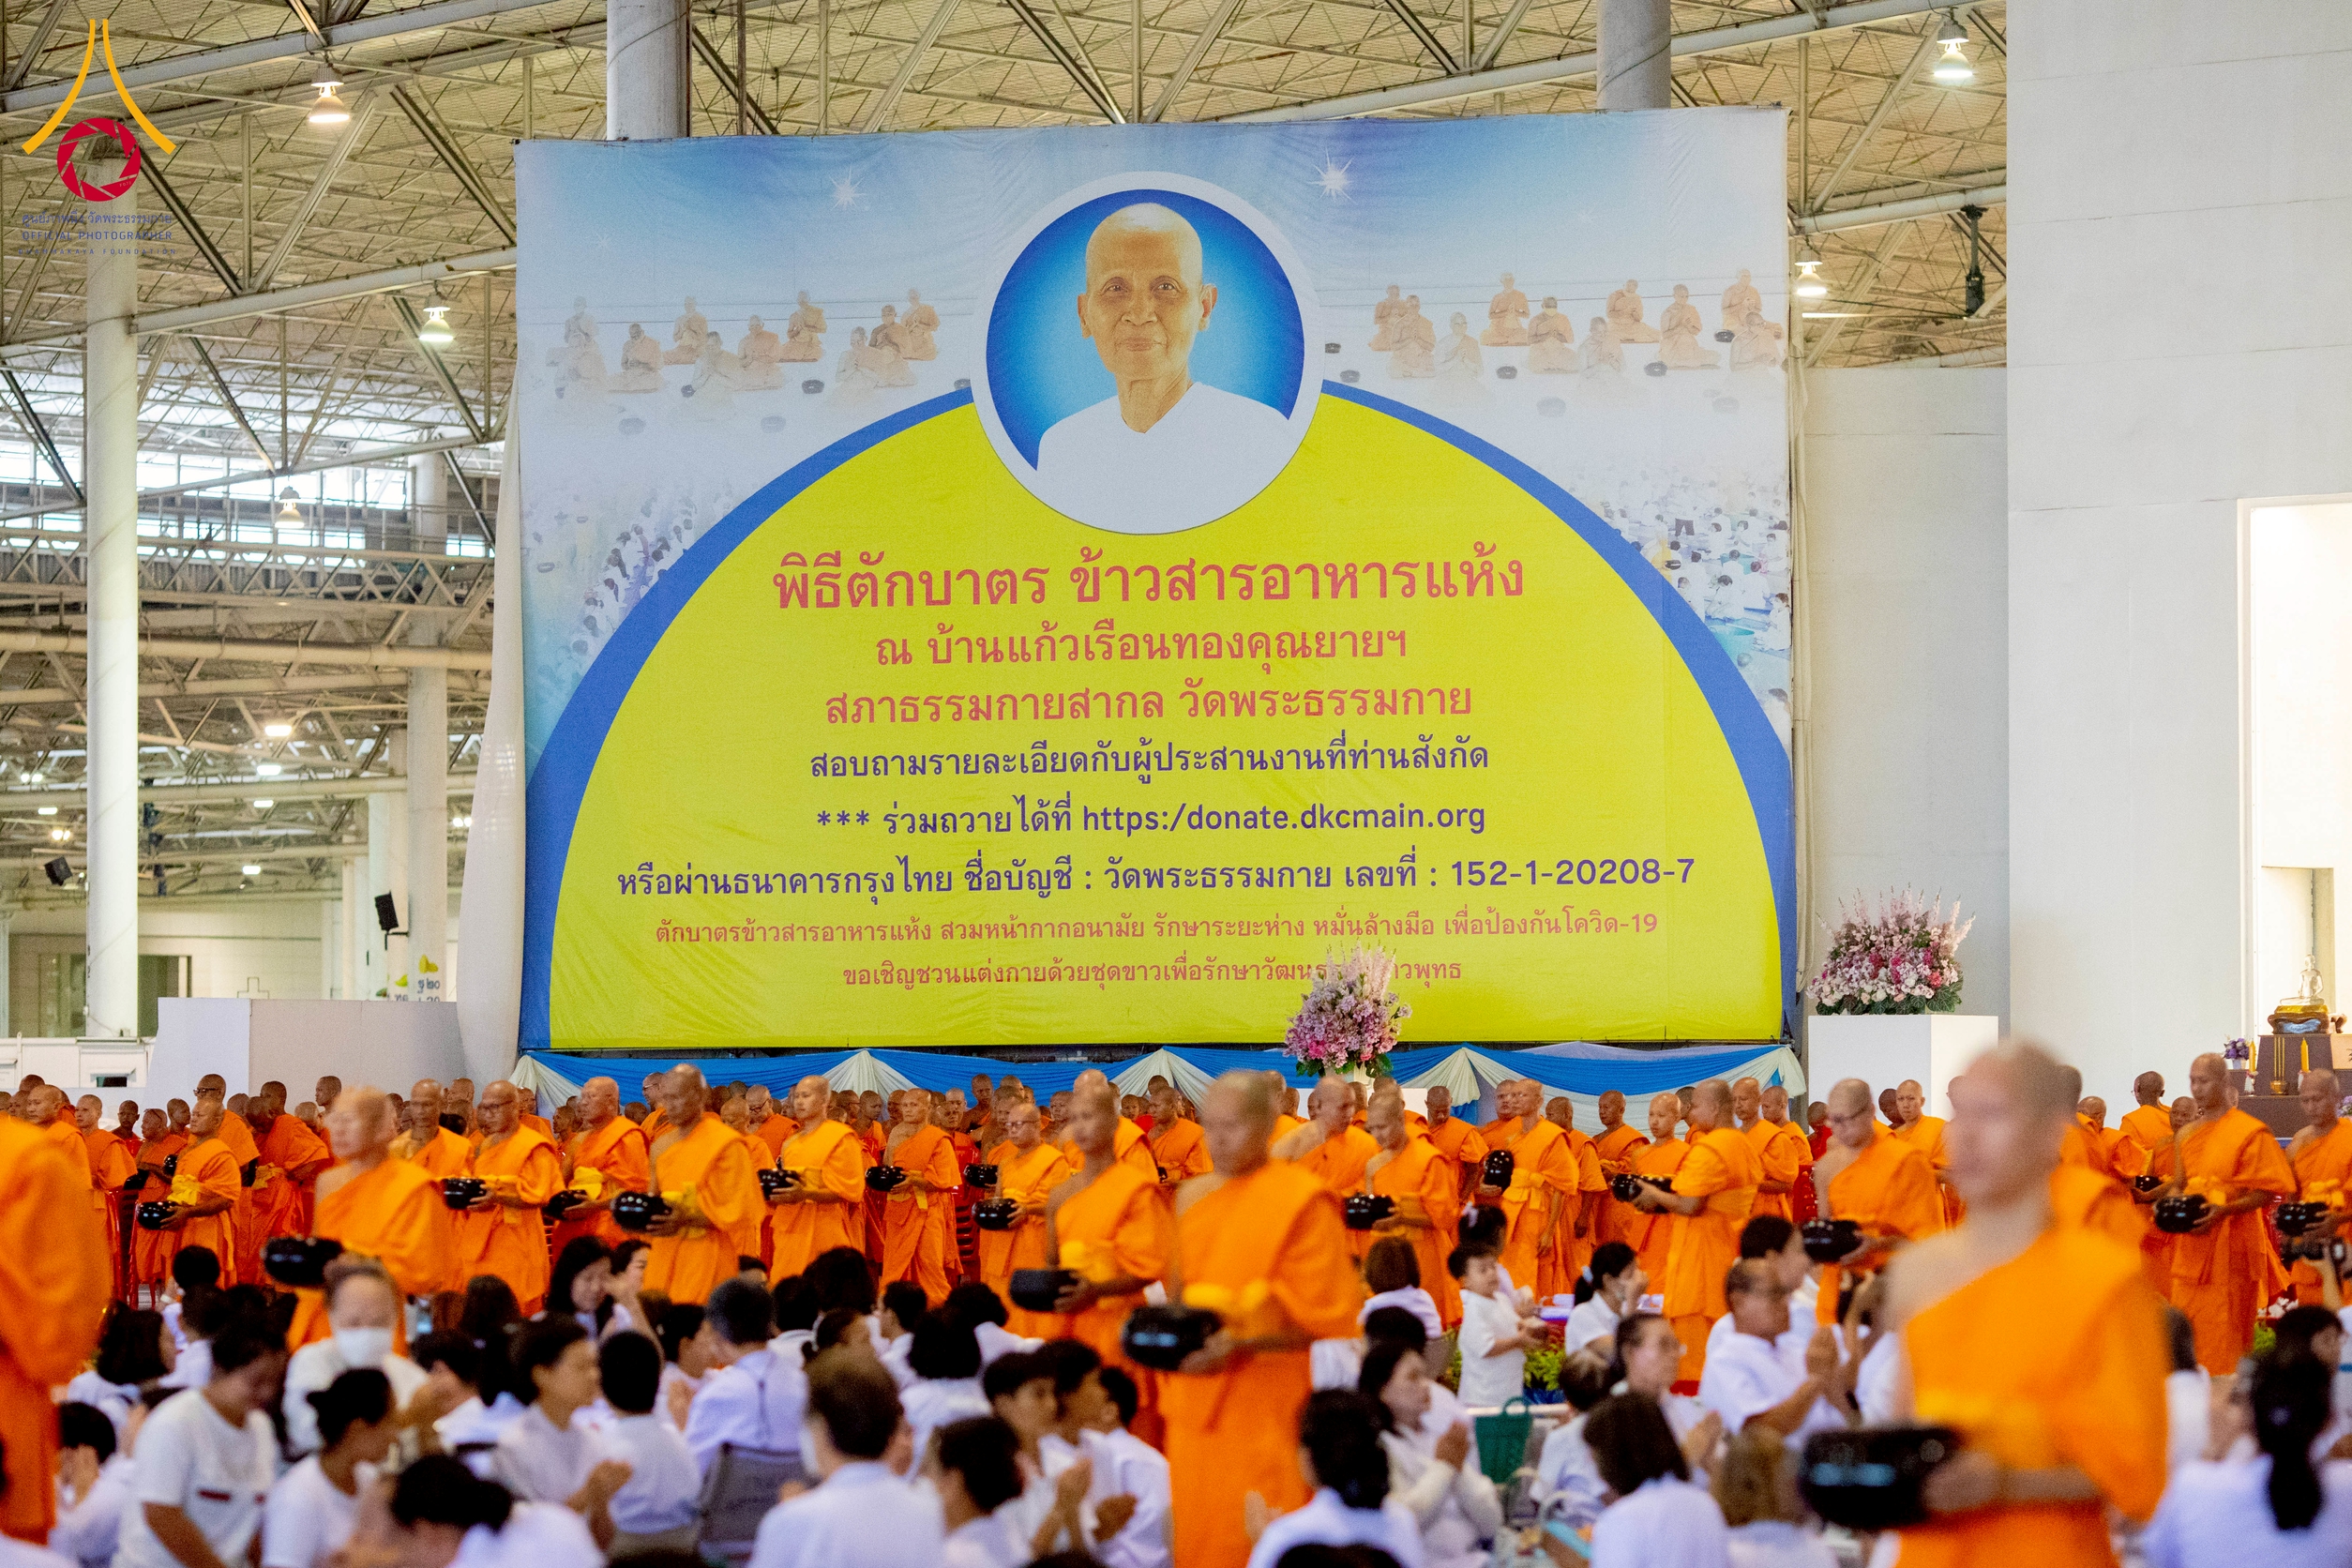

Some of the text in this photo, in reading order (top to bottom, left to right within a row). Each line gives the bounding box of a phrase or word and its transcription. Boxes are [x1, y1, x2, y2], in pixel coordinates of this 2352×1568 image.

[772, 541, 1523, 610] พิธีตักบาตร ข้าวสารอาหารแห้ง
[876, 618, 1406, 675] ณ บ้านแก้วเรือนทองคุณยายฯ
[825, 676, 1472, 724] สภาธรรมกายสากล วัดพระธรรมกาย
[810, 730, 1489, 785] สอบถามรายละเอียดกับผู้ประสานงานที่ท่านสังกัด
[882, 791, 1071, 835] ร่วมถวายได้ที่
[1083, 802, 1485, 838] https:/donate.dkcmain.org
[617, 854, 954, 906] หรือผ่านธนาคารกรุงไทย
[964, 849, 1073, 899] ชื่อบัญชี
[1104, 855, 1333, 889] วัดพระธรรมกาย
[1345, 844, 1417, 888] เลขที่
[1451, 858, 1696, 886] 152-1-20208-7
[656, 904, 1658, 943] ตักบาตรข้าวสารอาหารแห้ง สวมหน้ากากอนามัย รักษาระยะห่าง หมั่นล้างมือ เพื่อป้องกันโควิด-19
